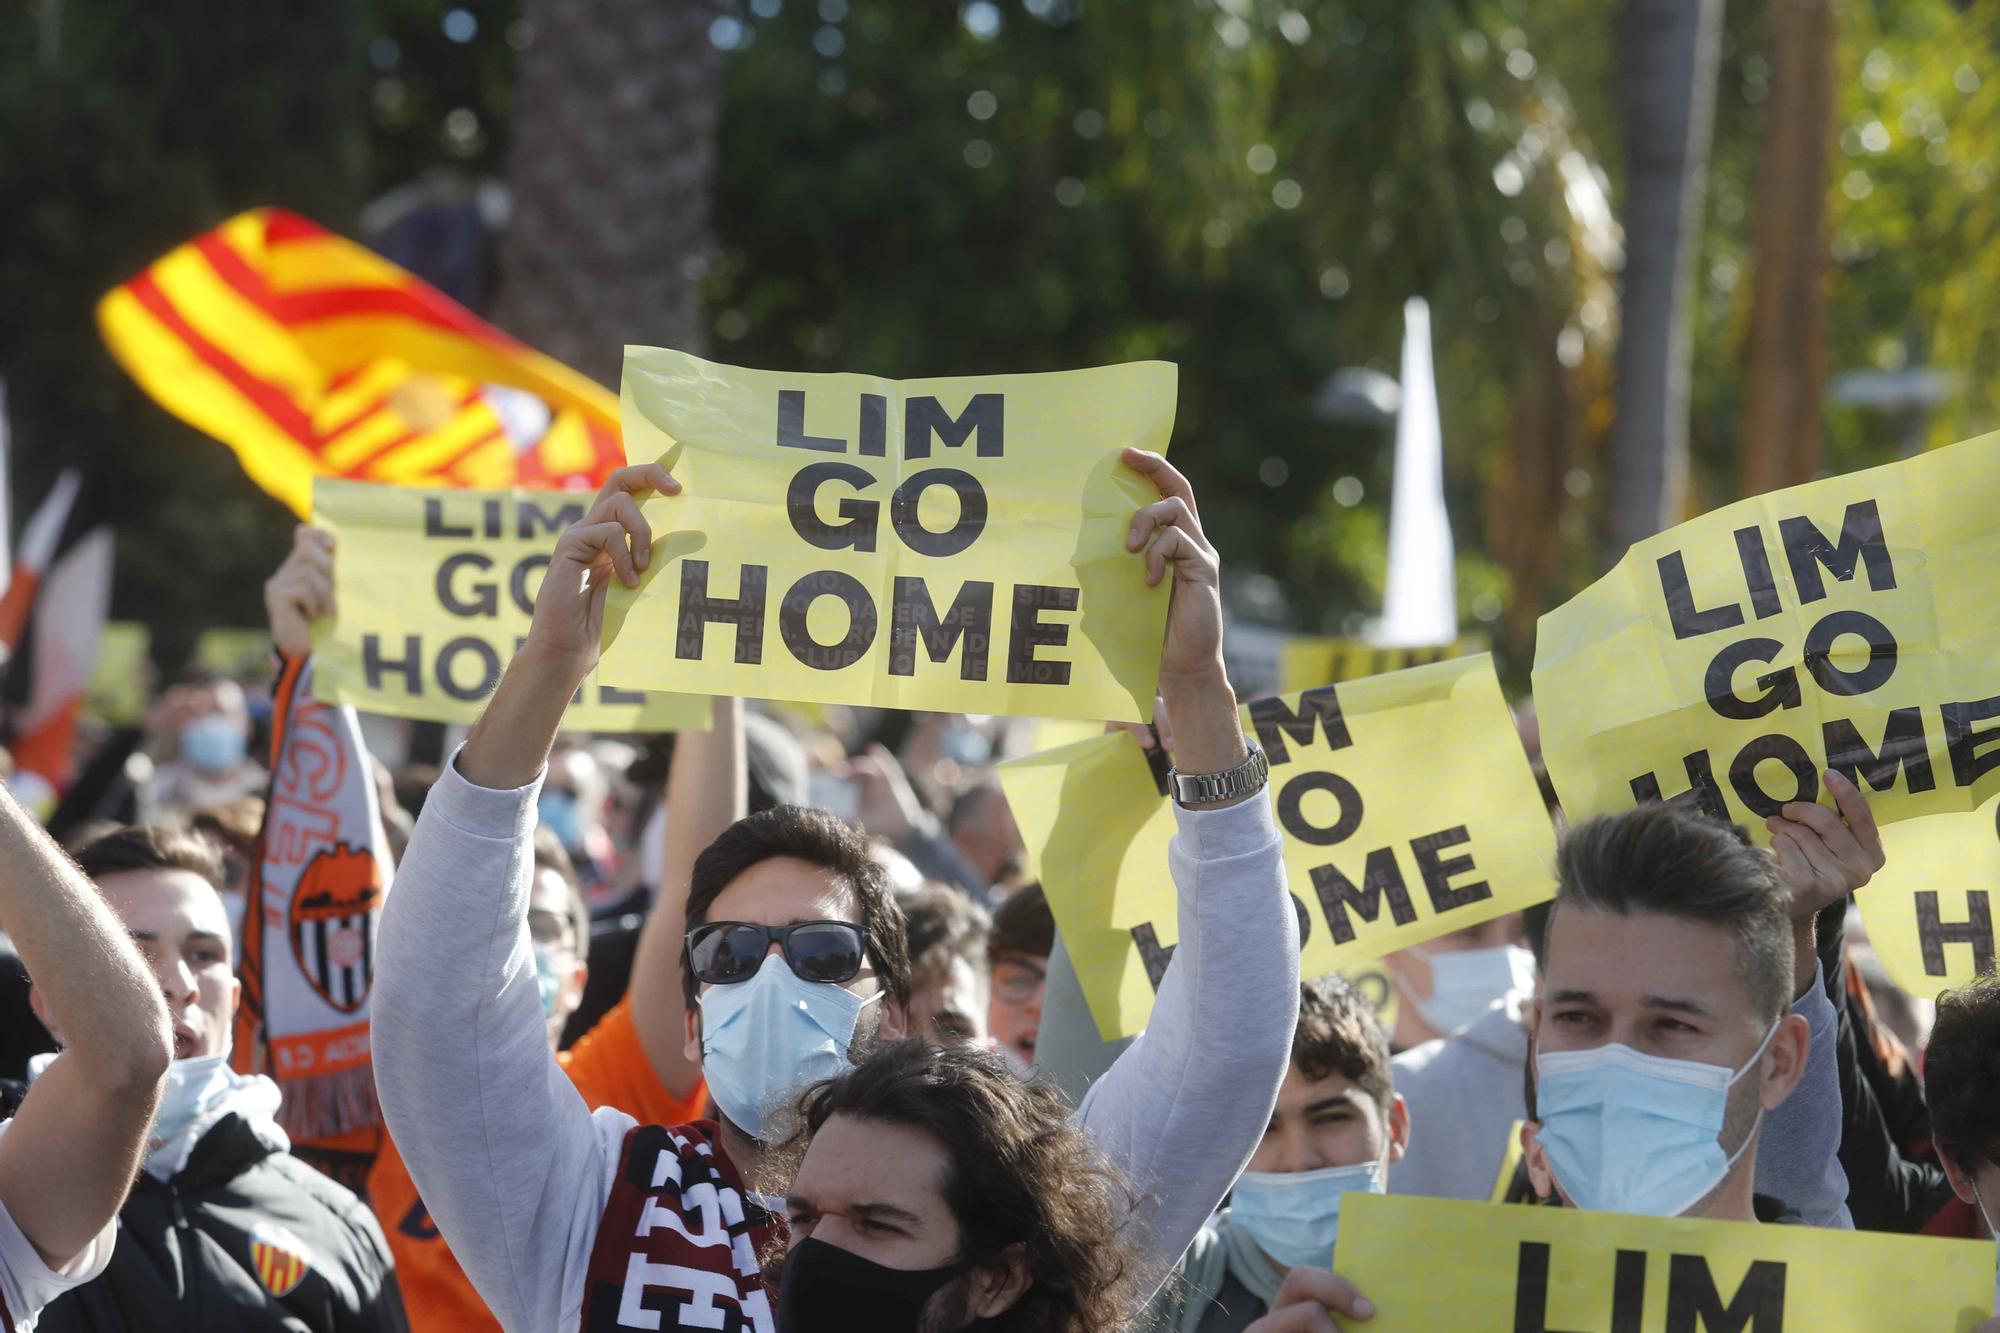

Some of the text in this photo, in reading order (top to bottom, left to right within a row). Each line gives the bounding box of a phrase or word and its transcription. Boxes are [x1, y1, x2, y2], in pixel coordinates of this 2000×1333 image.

[777, 389, 1005, 461] LIM
[786, 461, 988, 558] GO
[1656, 498, 1898, 641] LIM
[675, 559, 1081, 687] HOME
[1703, 609, 1898, 720] GO
[1277, 771, 1364, 847] O
[1514, 1240, 1788, 1333] LIM
